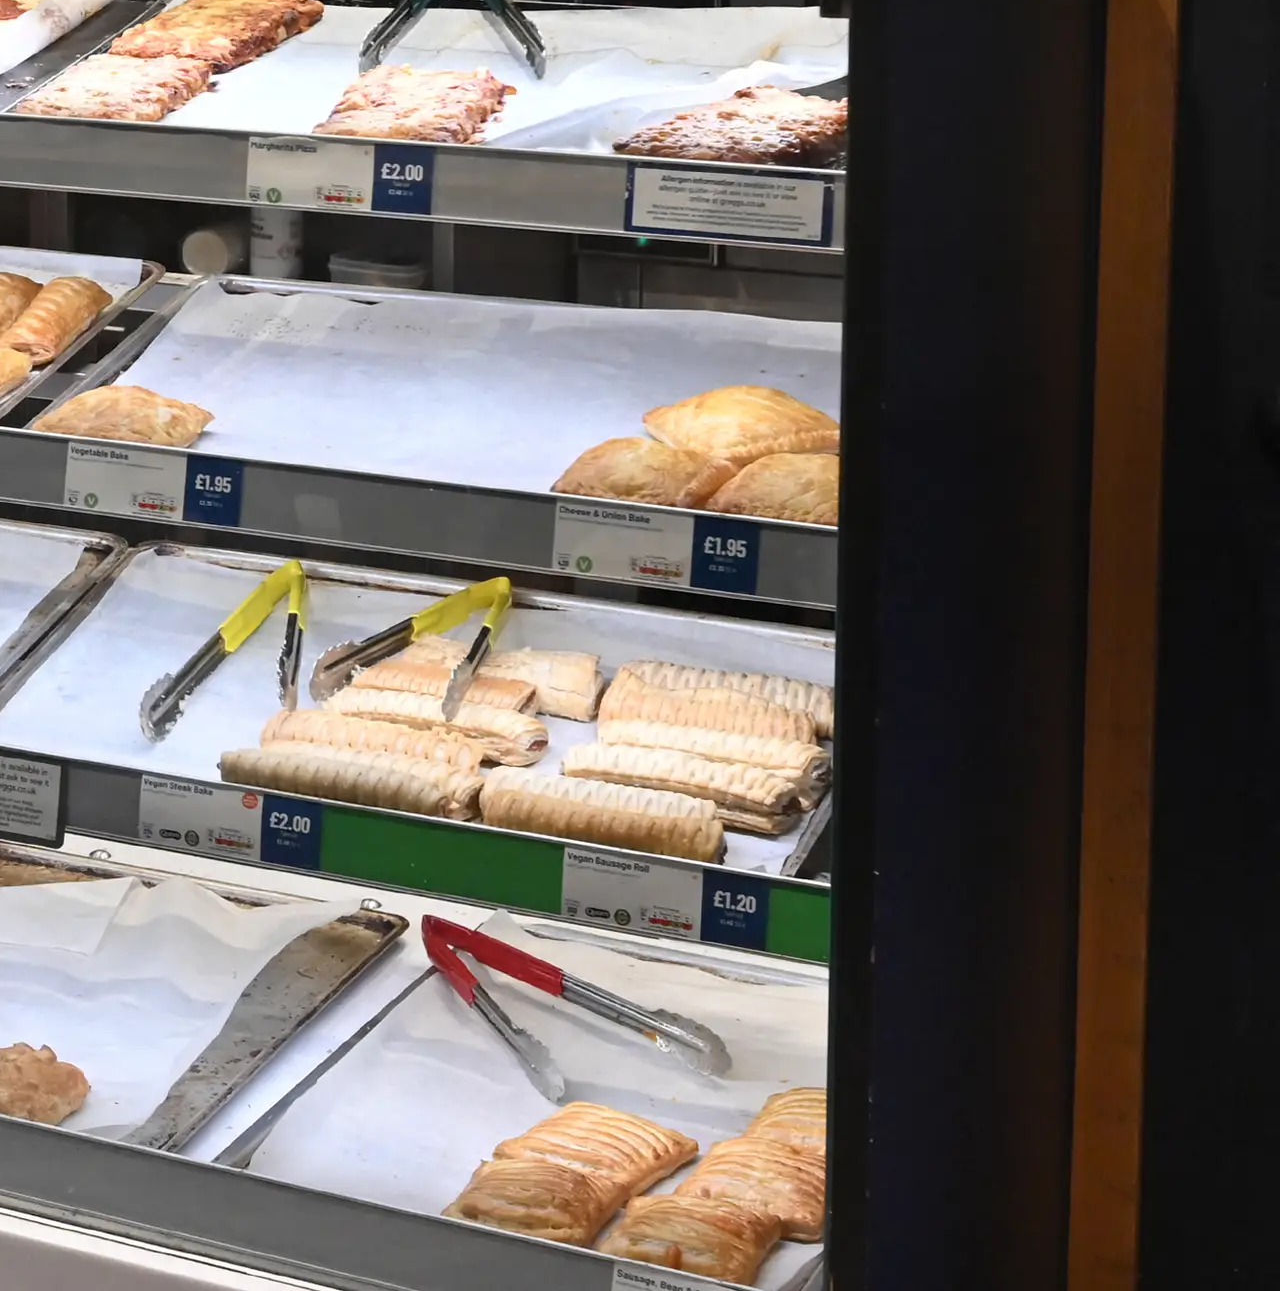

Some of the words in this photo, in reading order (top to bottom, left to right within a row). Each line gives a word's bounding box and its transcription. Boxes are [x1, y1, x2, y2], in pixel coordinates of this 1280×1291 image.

[250, 141, 294, 153] Margherita
[296, 144, 317, 153] Pizza
[381, 163, 423, 181] £2.00
[71, 446, 109, 458] Vegetable
[110, 450, 129, 460] Bake
[195, 474, 232, 493] £1.95
[559, 506, 591, 516] Cheese
[593, 509, 599, 517] &
[601, 511, 627, 521] Onion
[629, 514, 651, 524] Bake
[704, 536, 747, 558] £1.95
[8, 764, 42, 775] available
[143, 778, 168, 789] Vegan
[169, 782, 192, 793] Steak
[194, 786, 213, 796] Bake
[269, 812, 311, 833] £2.00
[568, 852, 593, 864] Vegan
[595, 856, 632, 872] Sausage
[634, 863, 650, 873] Roll
[713, 890, 757, 914] £1.20
[616, 1269, 658, 1288] Sausage,
[661, 1281, 683, 1291] Bean
